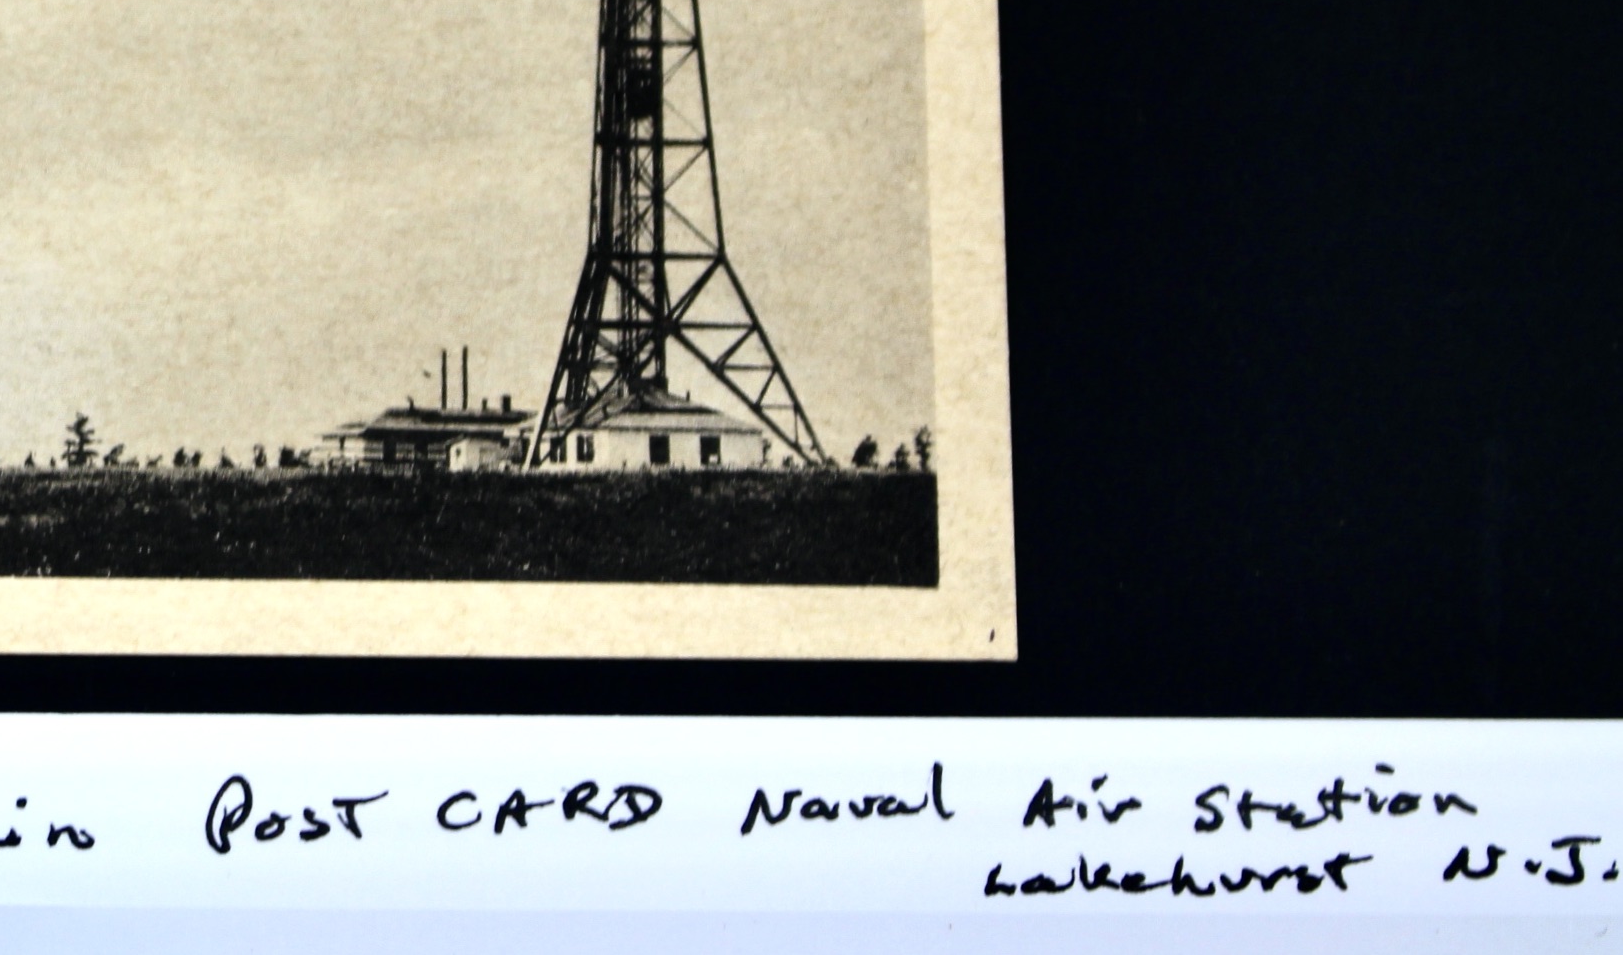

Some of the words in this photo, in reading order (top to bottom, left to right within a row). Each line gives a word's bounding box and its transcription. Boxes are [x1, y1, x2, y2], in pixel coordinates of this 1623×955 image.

[435, 780, 664, 835] CARD
[739, 760, 956, 837] Naval
[1021, 773, 1143, 829] Air
[1193, 762, 1478, 834] Station
